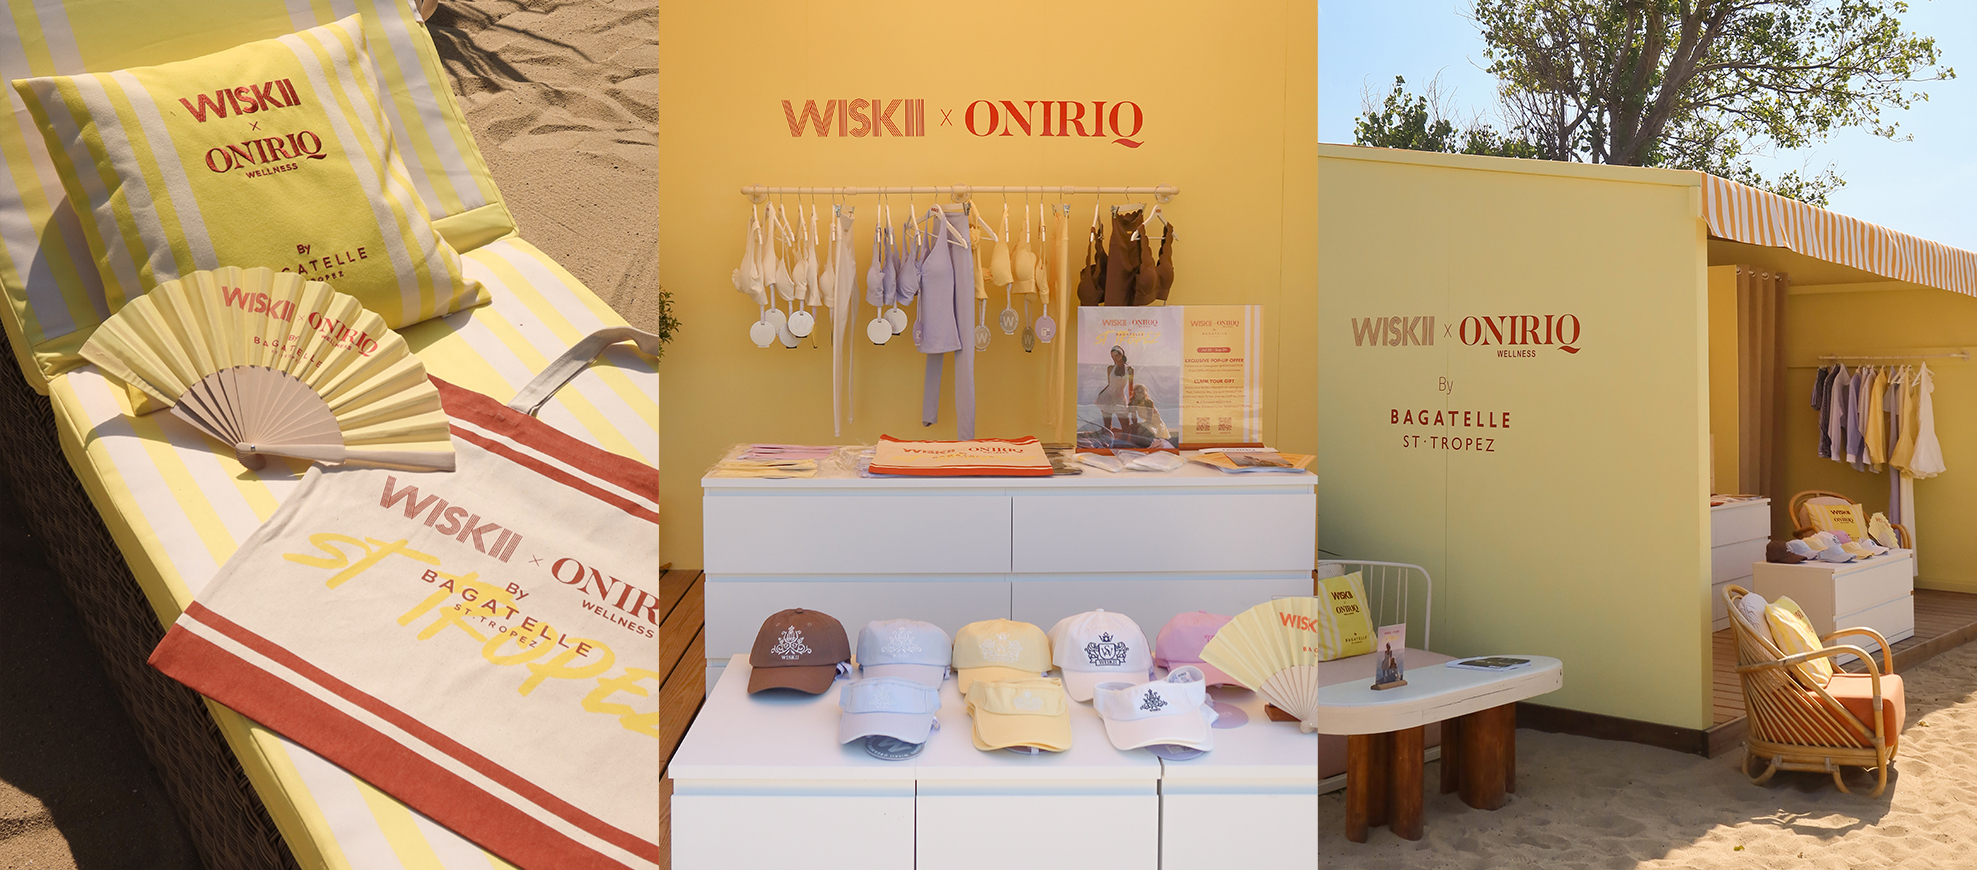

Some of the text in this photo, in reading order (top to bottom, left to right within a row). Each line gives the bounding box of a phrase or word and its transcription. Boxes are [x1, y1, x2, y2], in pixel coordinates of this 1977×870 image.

[179, 78, 302, 123] WISKII
[780, 98, 925, 138] WISKII
[964, 100, 1145, 148] ONIRIQ
[205, 130, 328, 173] ONIRIQ
[245, 162, 299, 179] WELLNESS
[297, 244, 311, 255] By
[222, 286, 296, 323] WISKII
[308, 311, 379, 357] ONIRIQ
[1102, 319, 1127, 327] WISKII
[1351, 316, 1435, 347] WISKII
[1459, 313, 1581, 354] ONIRIQ
[254, 336, 323, 368] BAGATELLE
[1496, 349, 1536, 358] WELLNESS
[1438, 376, 1454, 395] By
[1390, 409, 1510, 428] BAGATELLE
[379, 475, 523, 563] WISKII
[505, 582, 529, 601] By
[421, 569, 592, 657] BAGATELLE
[582, 599, 655, 639] WELLNESS
[1279, 611, 1318, 633] WISK
